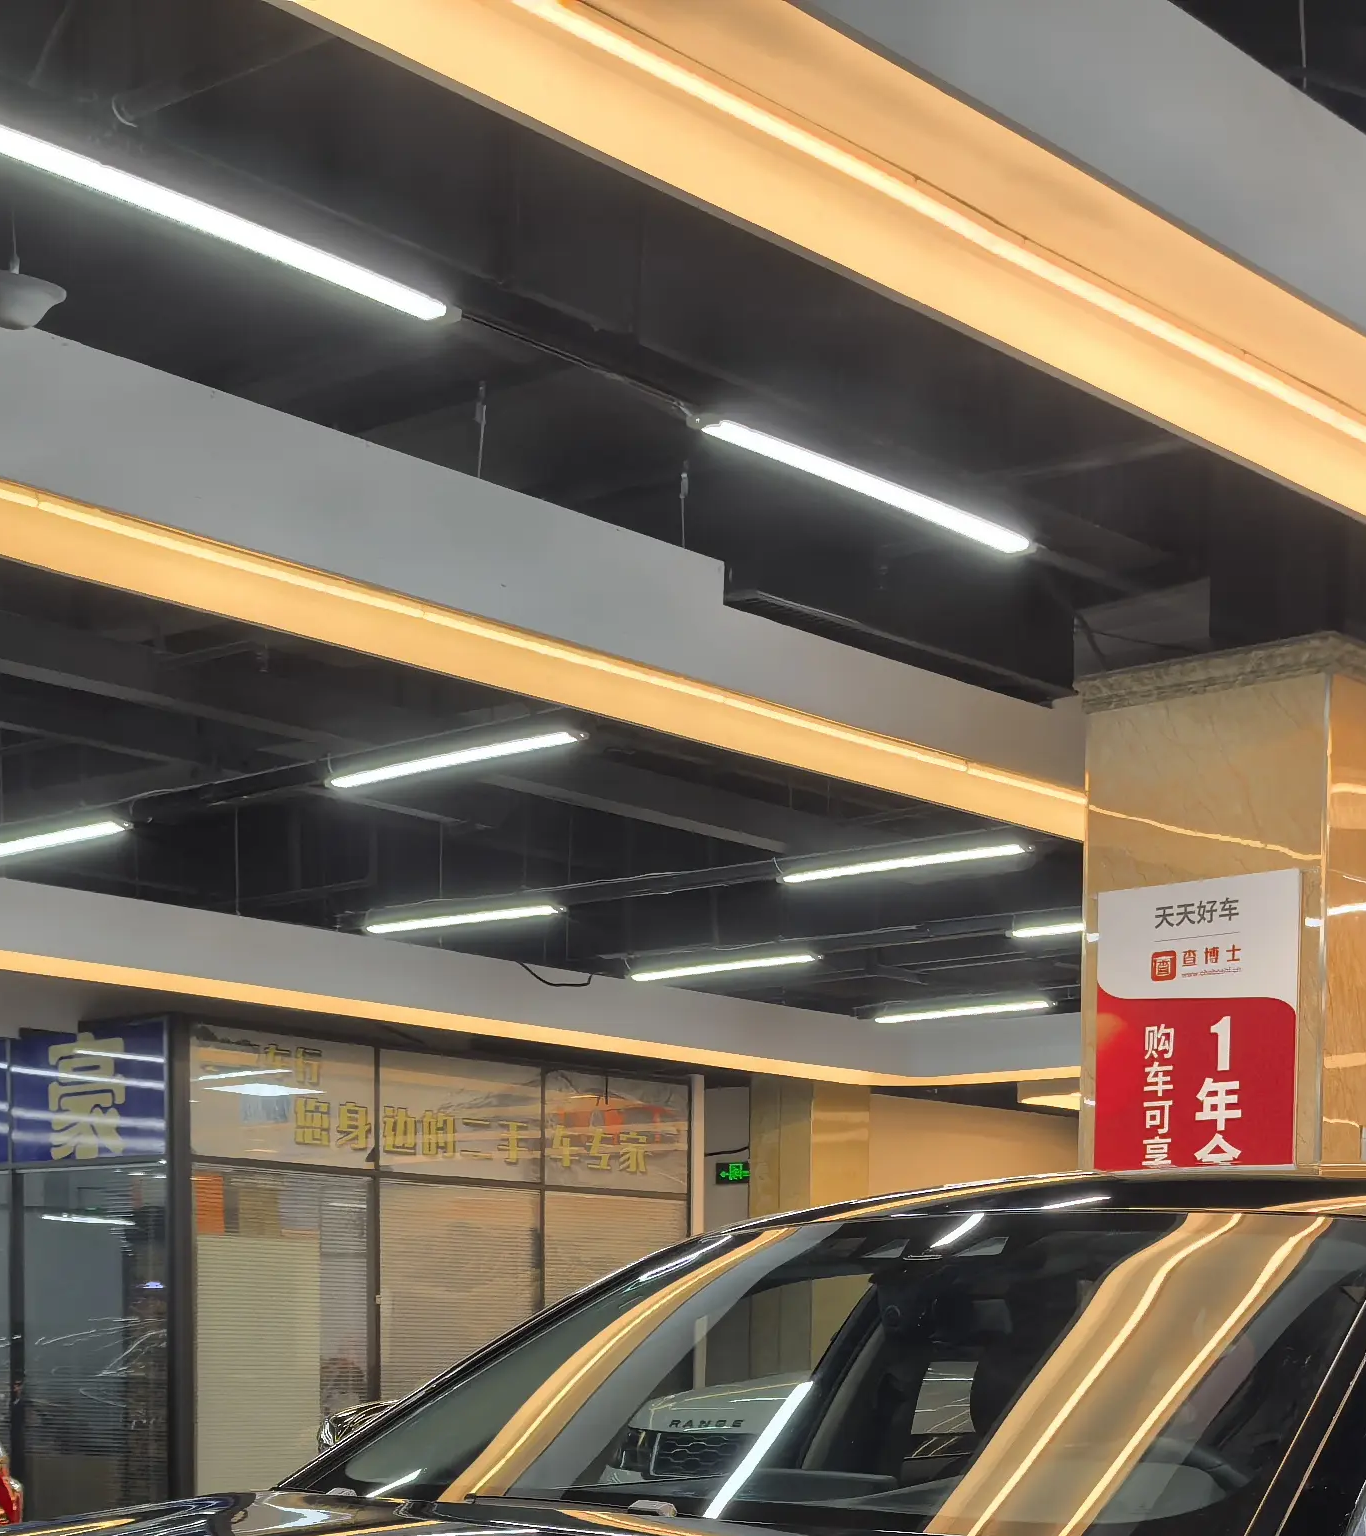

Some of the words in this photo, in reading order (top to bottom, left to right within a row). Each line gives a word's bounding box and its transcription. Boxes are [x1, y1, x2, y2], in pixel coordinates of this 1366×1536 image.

[1154, 897, 1240, 929] 天天好车
[1181, 944, 1242, 967] 查博士
[1142, 1024, 1175, 1166] 购车可享
[293, 1096, 648, 1176] 您身边的二手车专家
[668, 1418, 745, 1429] RANGE
